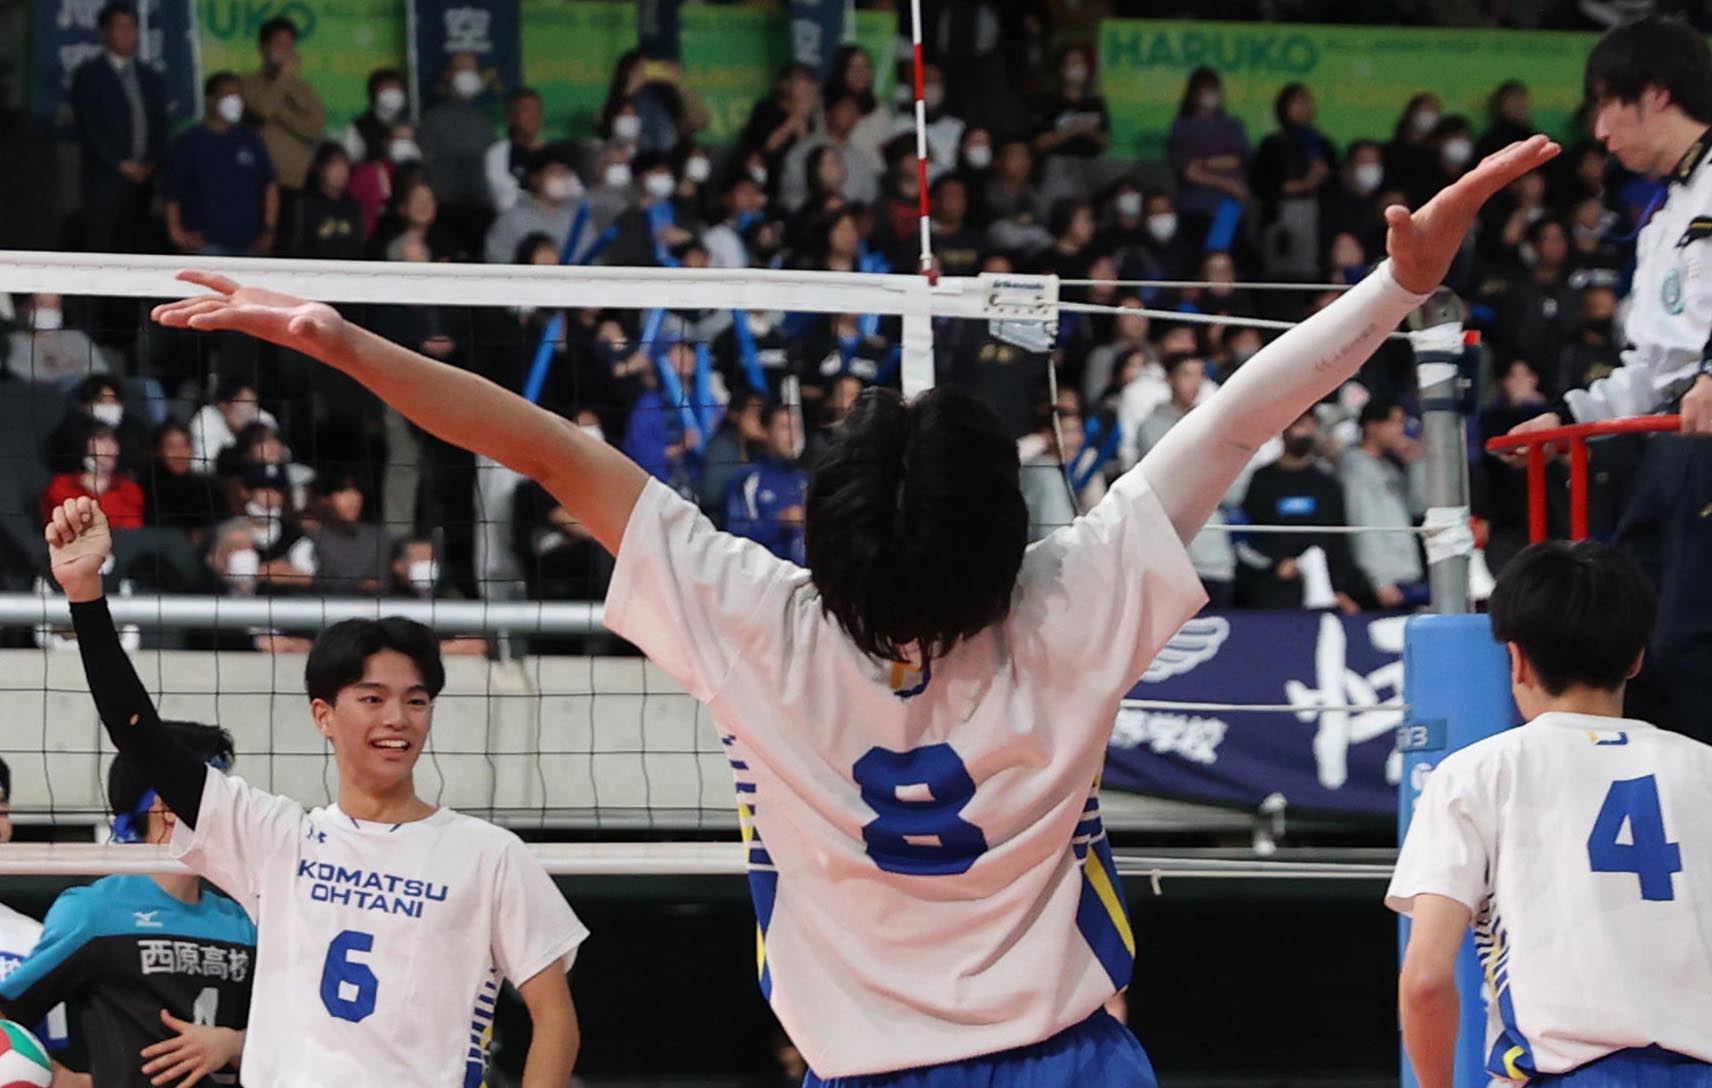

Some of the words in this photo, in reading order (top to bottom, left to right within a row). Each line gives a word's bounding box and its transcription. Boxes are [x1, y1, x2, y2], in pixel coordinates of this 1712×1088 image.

[1109, 29, 1320, 74] HARUKO
[852, 742, 989, 876] 8
[1587, 774, 1683, 901] 4
[297, 858, 449, 902] KOMATSU
[310, 883, 424, 919] OHTANI
[138, 940, 249, 982] 西原高校
[320, 929, 379, 1024] 6
